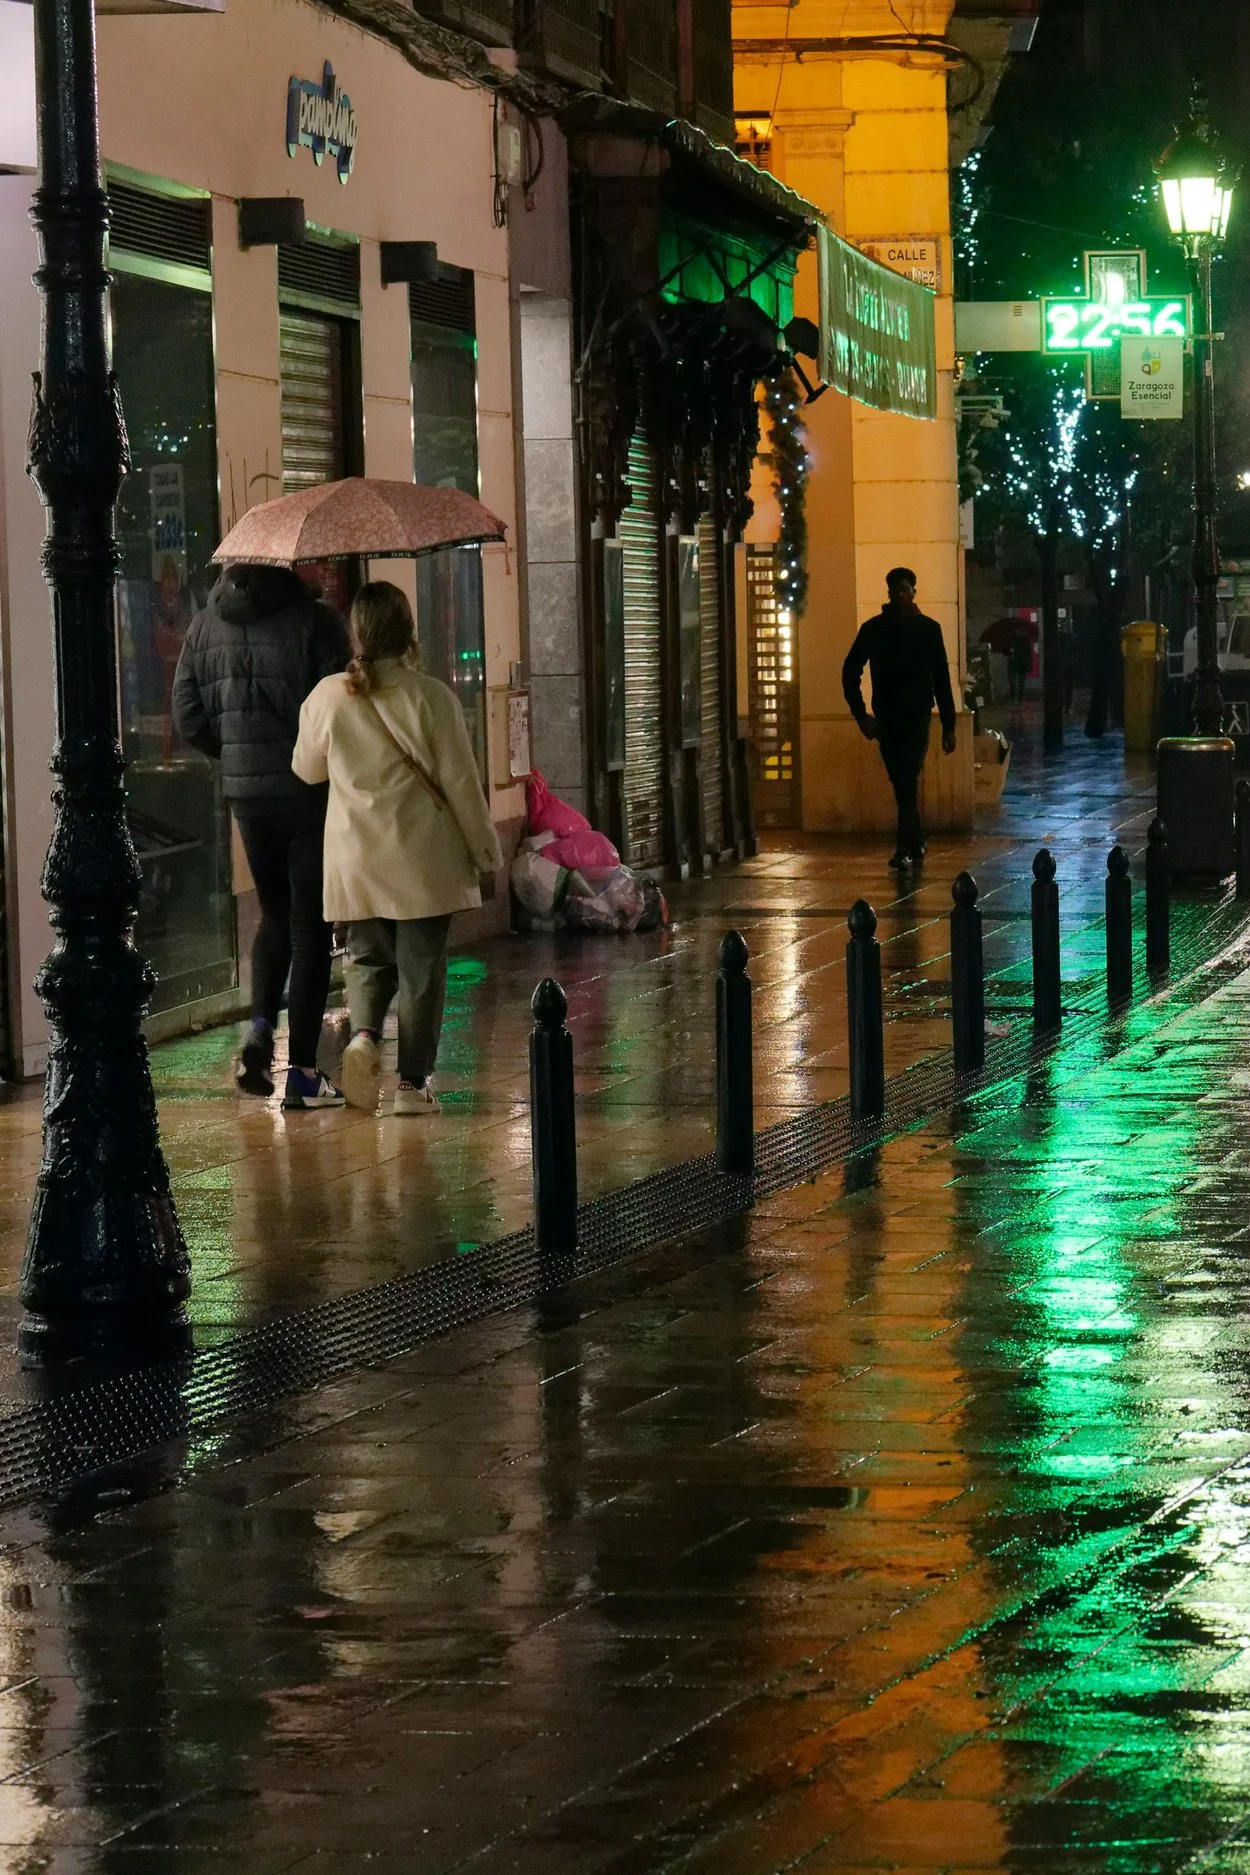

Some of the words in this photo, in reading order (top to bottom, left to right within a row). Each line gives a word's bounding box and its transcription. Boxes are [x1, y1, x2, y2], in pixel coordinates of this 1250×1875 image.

[294, 74, 358, 175] pampling
[887, 249, 927, 261] CALLE
[1047, 303, 1186, 347] 22:56
[1128, 381, 1175, 392] Zaragoza
[1131, 391, 1171, 400] Esencial
